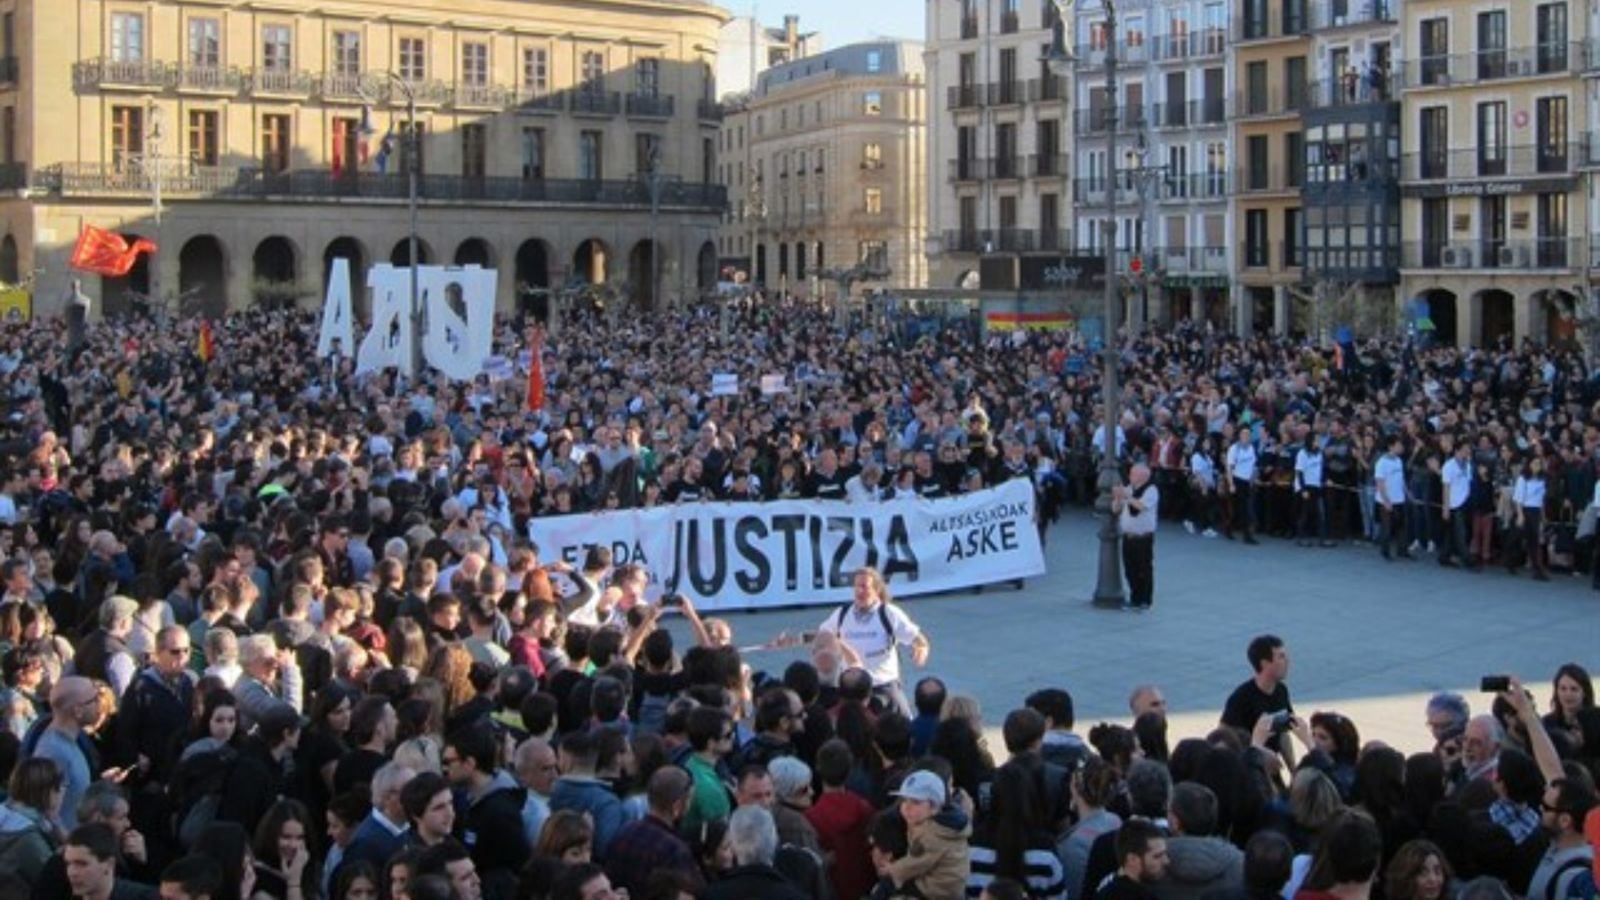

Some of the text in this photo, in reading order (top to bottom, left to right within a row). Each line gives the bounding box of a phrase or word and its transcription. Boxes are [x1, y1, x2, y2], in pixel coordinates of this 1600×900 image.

[612, 539, 648, 568] DA
[665, 514, 919, 597] JUSTIZIA
[946, 521, 1019, 562] ASKE
